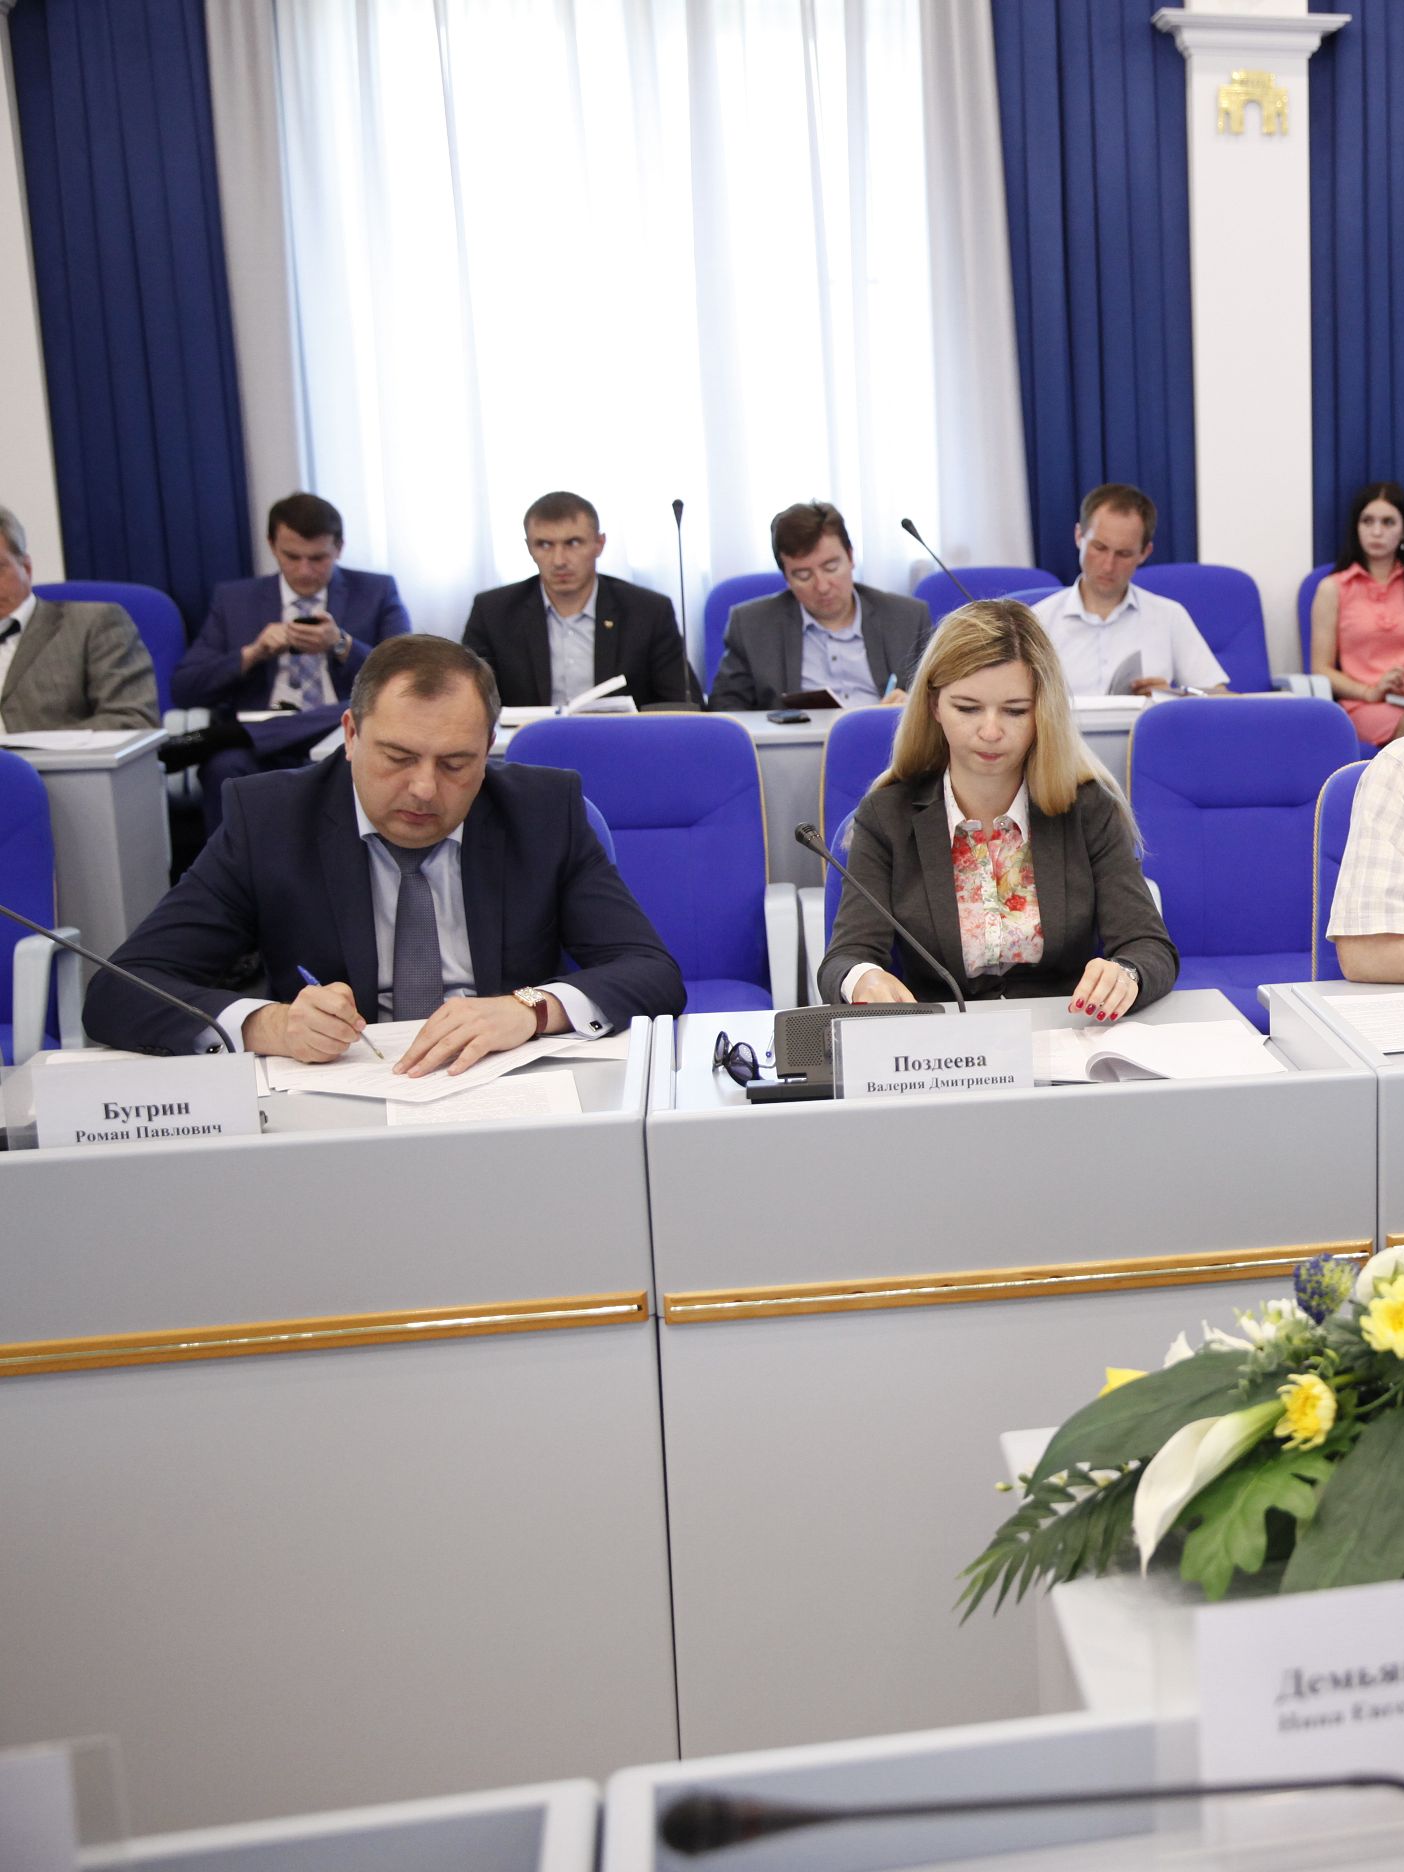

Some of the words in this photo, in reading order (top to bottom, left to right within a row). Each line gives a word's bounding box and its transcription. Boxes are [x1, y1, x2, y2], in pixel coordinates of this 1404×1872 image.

[893, 1053, 987, 1073] Поздеева
[866, 1079, 925, 1094] Валерия
[929, 1073, 1015, 1090] Дмитриевна
[103, 1101, 191, 1124] Бугрин
[75, 1129, 130, 1144] Роман
[136, 1123, 223, 1140] Павлович
